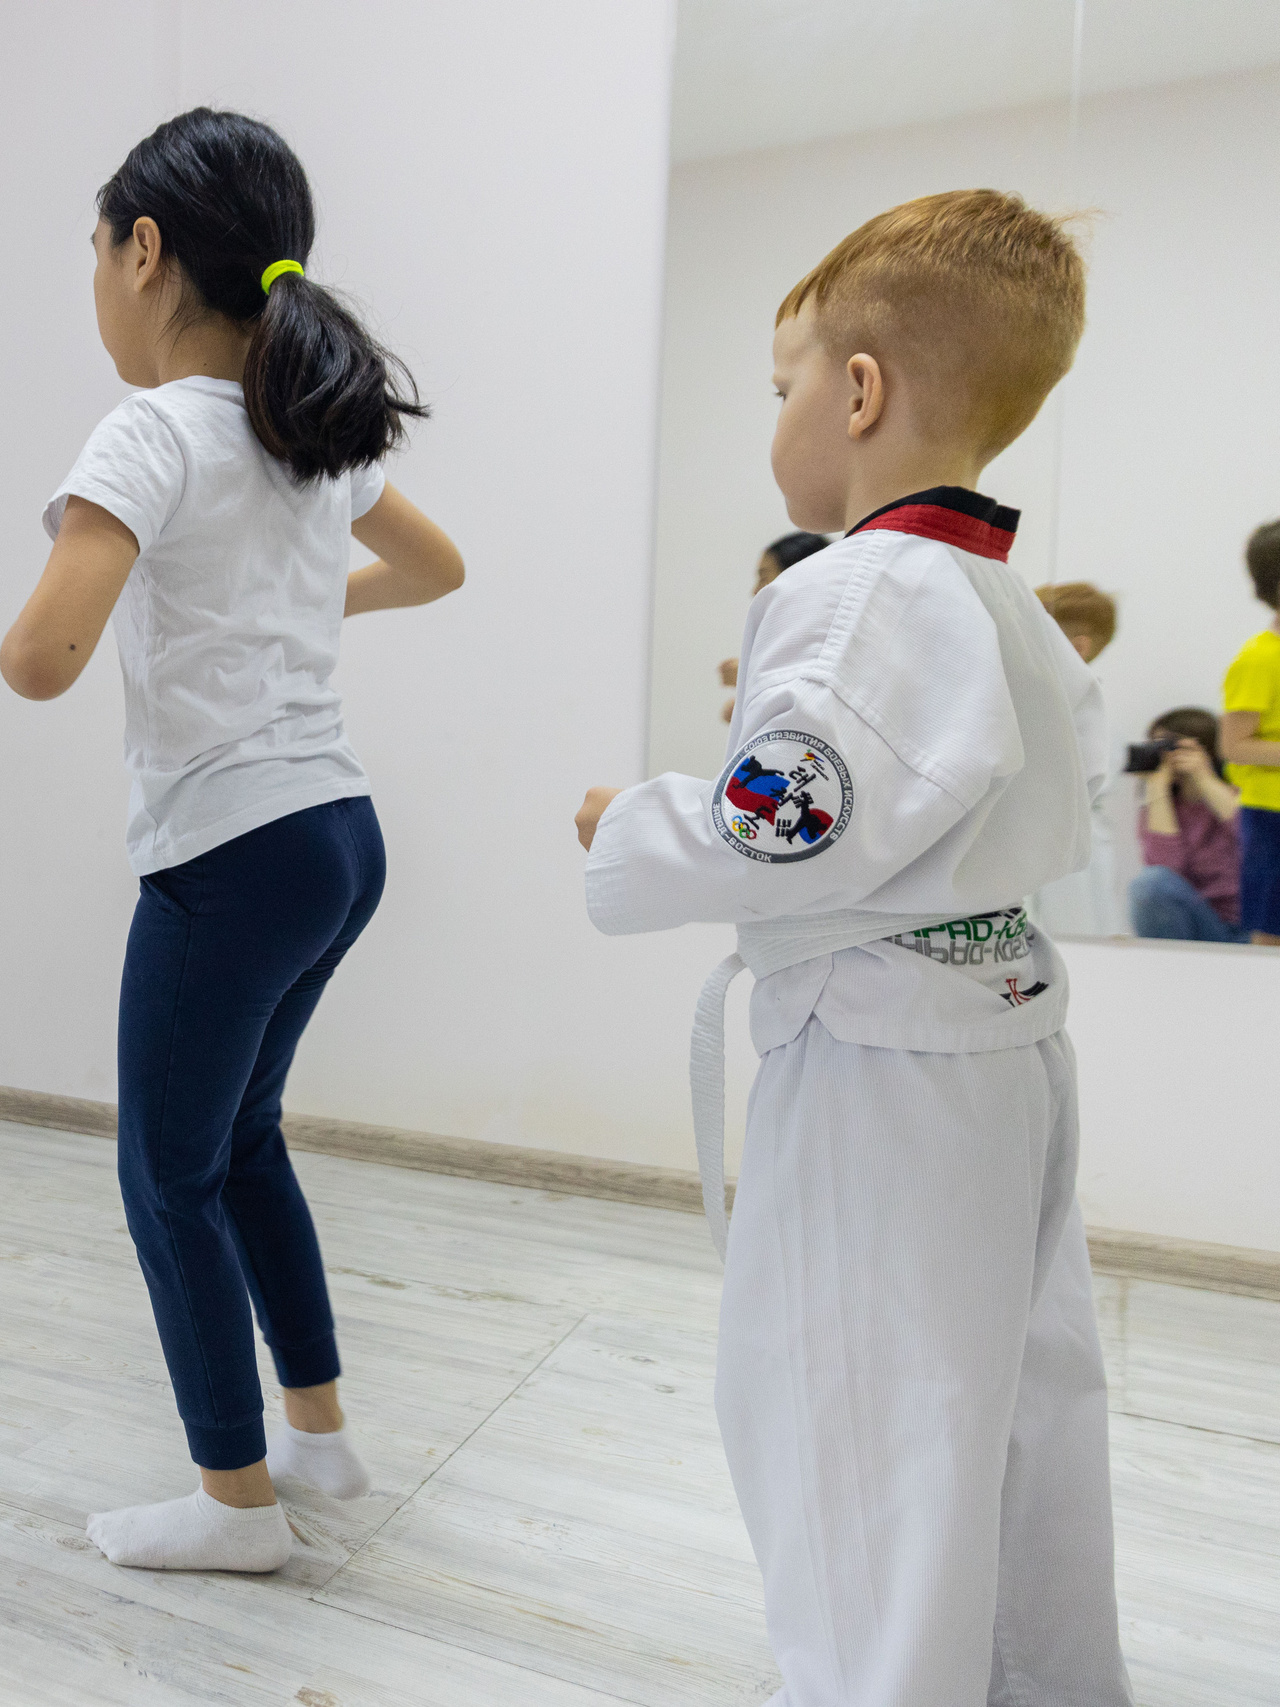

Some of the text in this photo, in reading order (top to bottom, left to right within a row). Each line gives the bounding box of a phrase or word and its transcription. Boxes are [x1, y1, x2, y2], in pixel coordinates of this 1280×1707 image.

[743, 735, 769, 753] СОЮЗ
[769, 731, 826, 751] РАЗВИТИЯ
[824, 746, 852, 788] БОЕВЫХ
[830, 788, 854, 841] ИСКУССТВ
